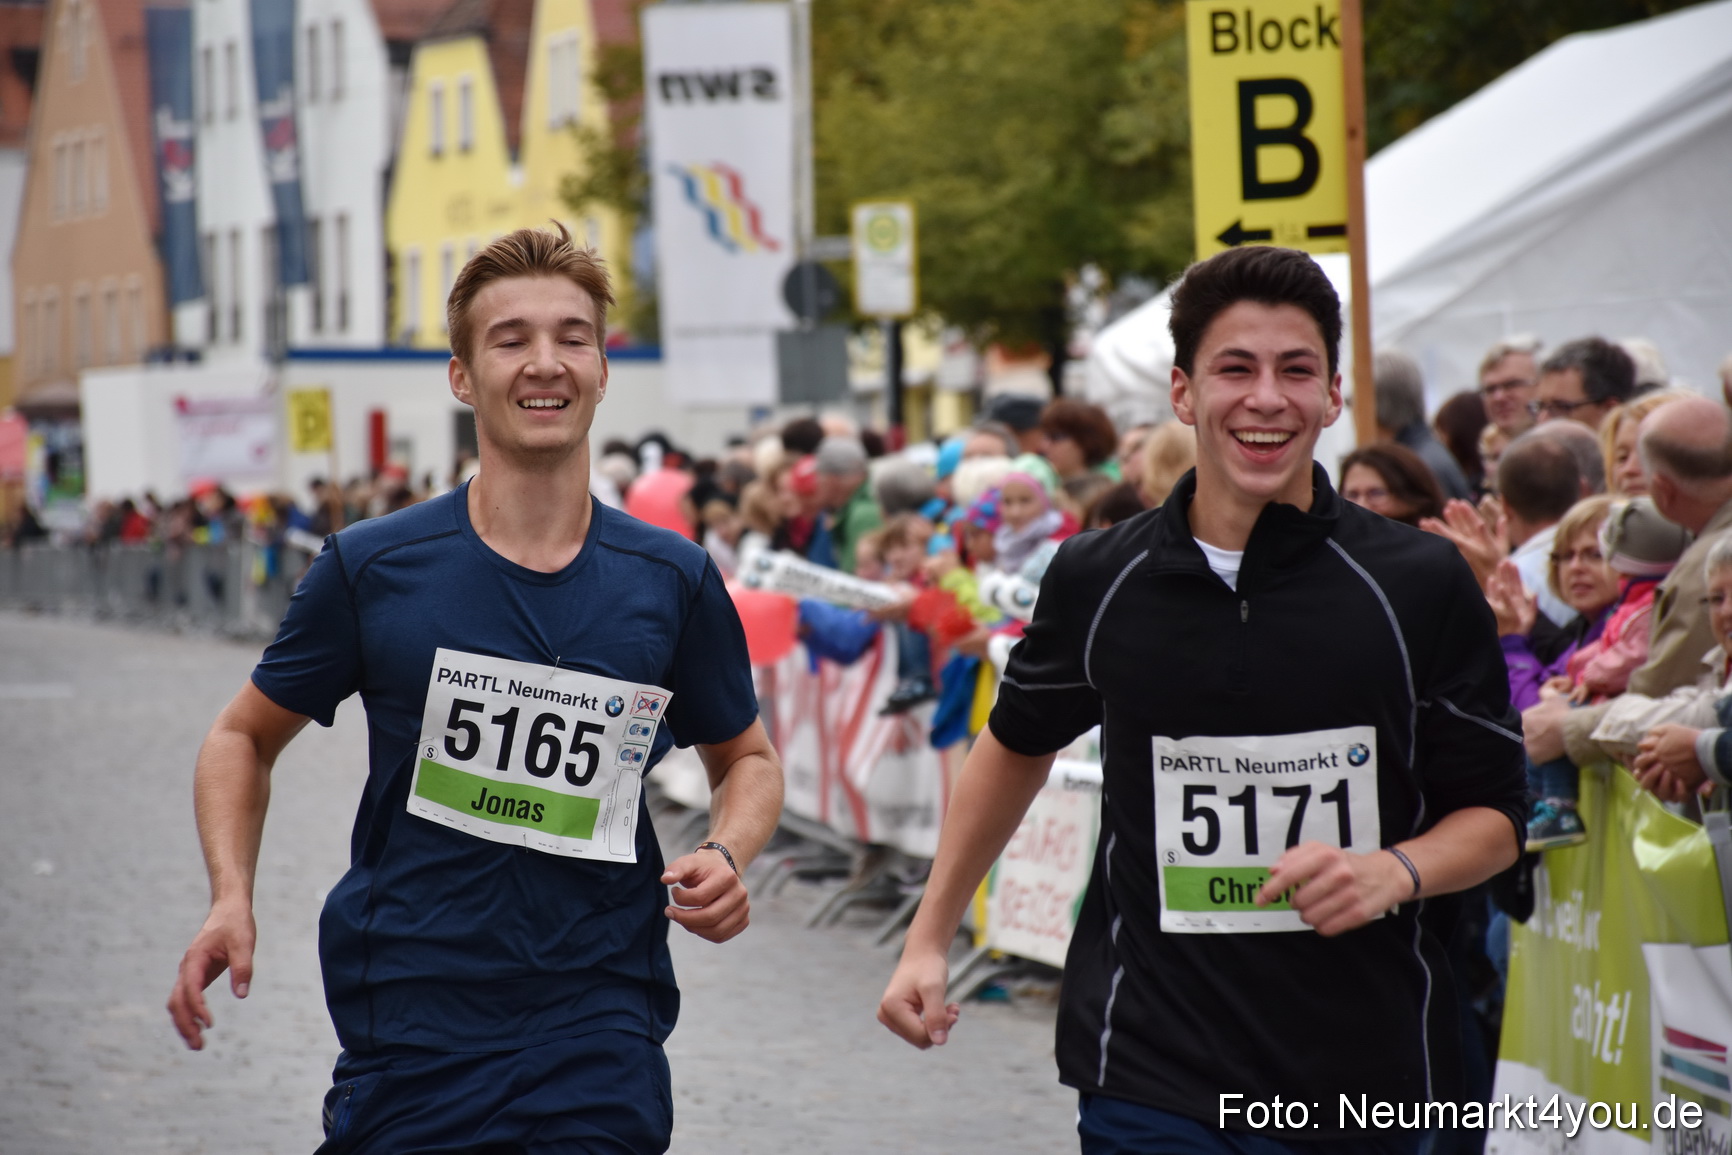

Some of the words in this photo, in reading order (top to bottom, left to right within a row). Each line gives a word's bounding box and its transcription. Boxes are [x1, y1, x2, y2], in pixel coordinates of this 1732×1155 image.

[1208, 9, 1341, 56] Block
[1238, 77, 1322, 203] B
[437, 667, 502, 694] PARTL
[508, 679, 599, 711] Neumarkt
[426, 747, 435, 759] S
[444, 698, 606, 787] 5165
[1160, 755, 1230, 774] PARTL
[1236, 752, 1339, 774] Neumarkt
[471, 787, 545, 823] Jonas
[1181, 778, 1353, 856] 5171
[1167, 851, 1175, 864] S
